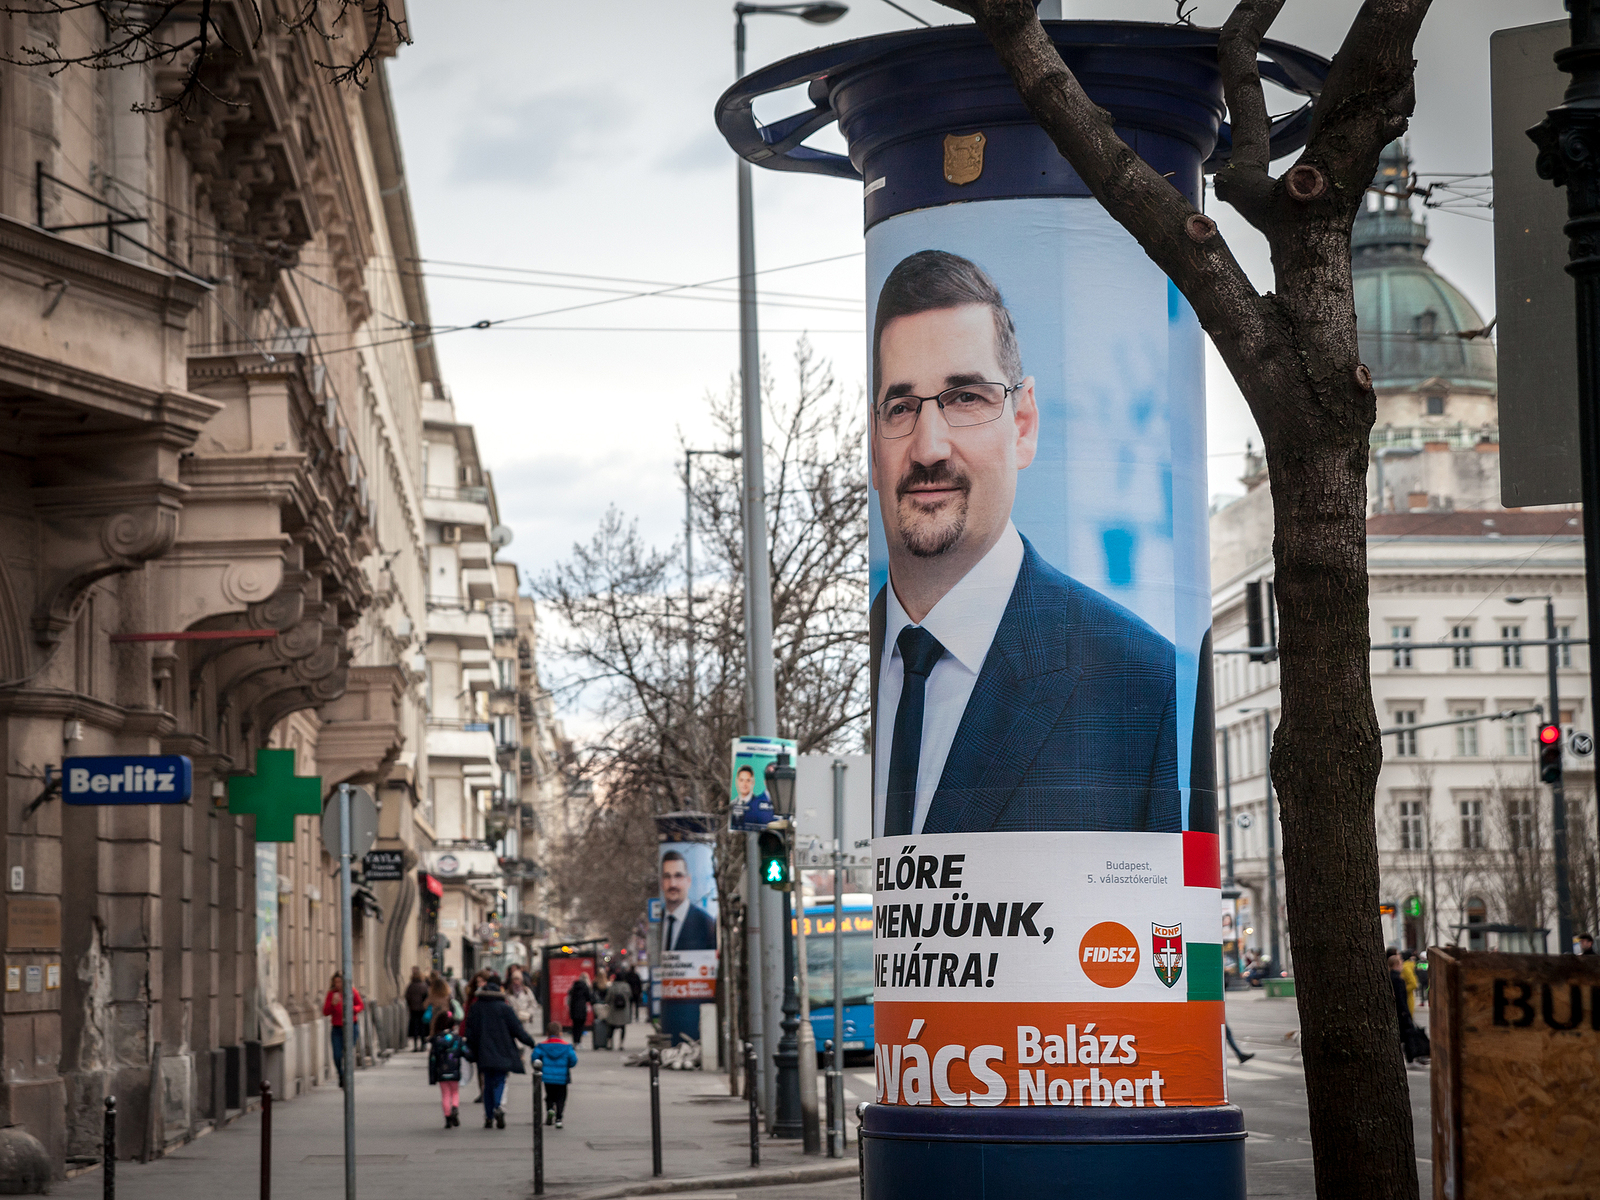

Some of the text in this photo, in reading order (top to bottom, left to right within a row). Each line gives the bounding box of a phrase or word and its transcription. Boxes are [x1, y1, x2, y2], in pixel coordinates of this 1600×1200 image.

[69, 765, 175, 793] Berlitz
[876, 845, 966, 892] ELŐRE
[1087, 874, 1168, 885] 5. választókerület
[1106, 860, 1152, 872] Budapest,
[875, 892, 1054, 945] MENJÜNK,
[1154, 926, 1180, 936] KDNP
[874, 942, 999, 988] NE HÁTRA!
[1082, 947, 1136, 963] FIDESZ
[1017, 1023, 1138, 1065] Balázs
[1018, 1068, 1167, 1107] Norbert
